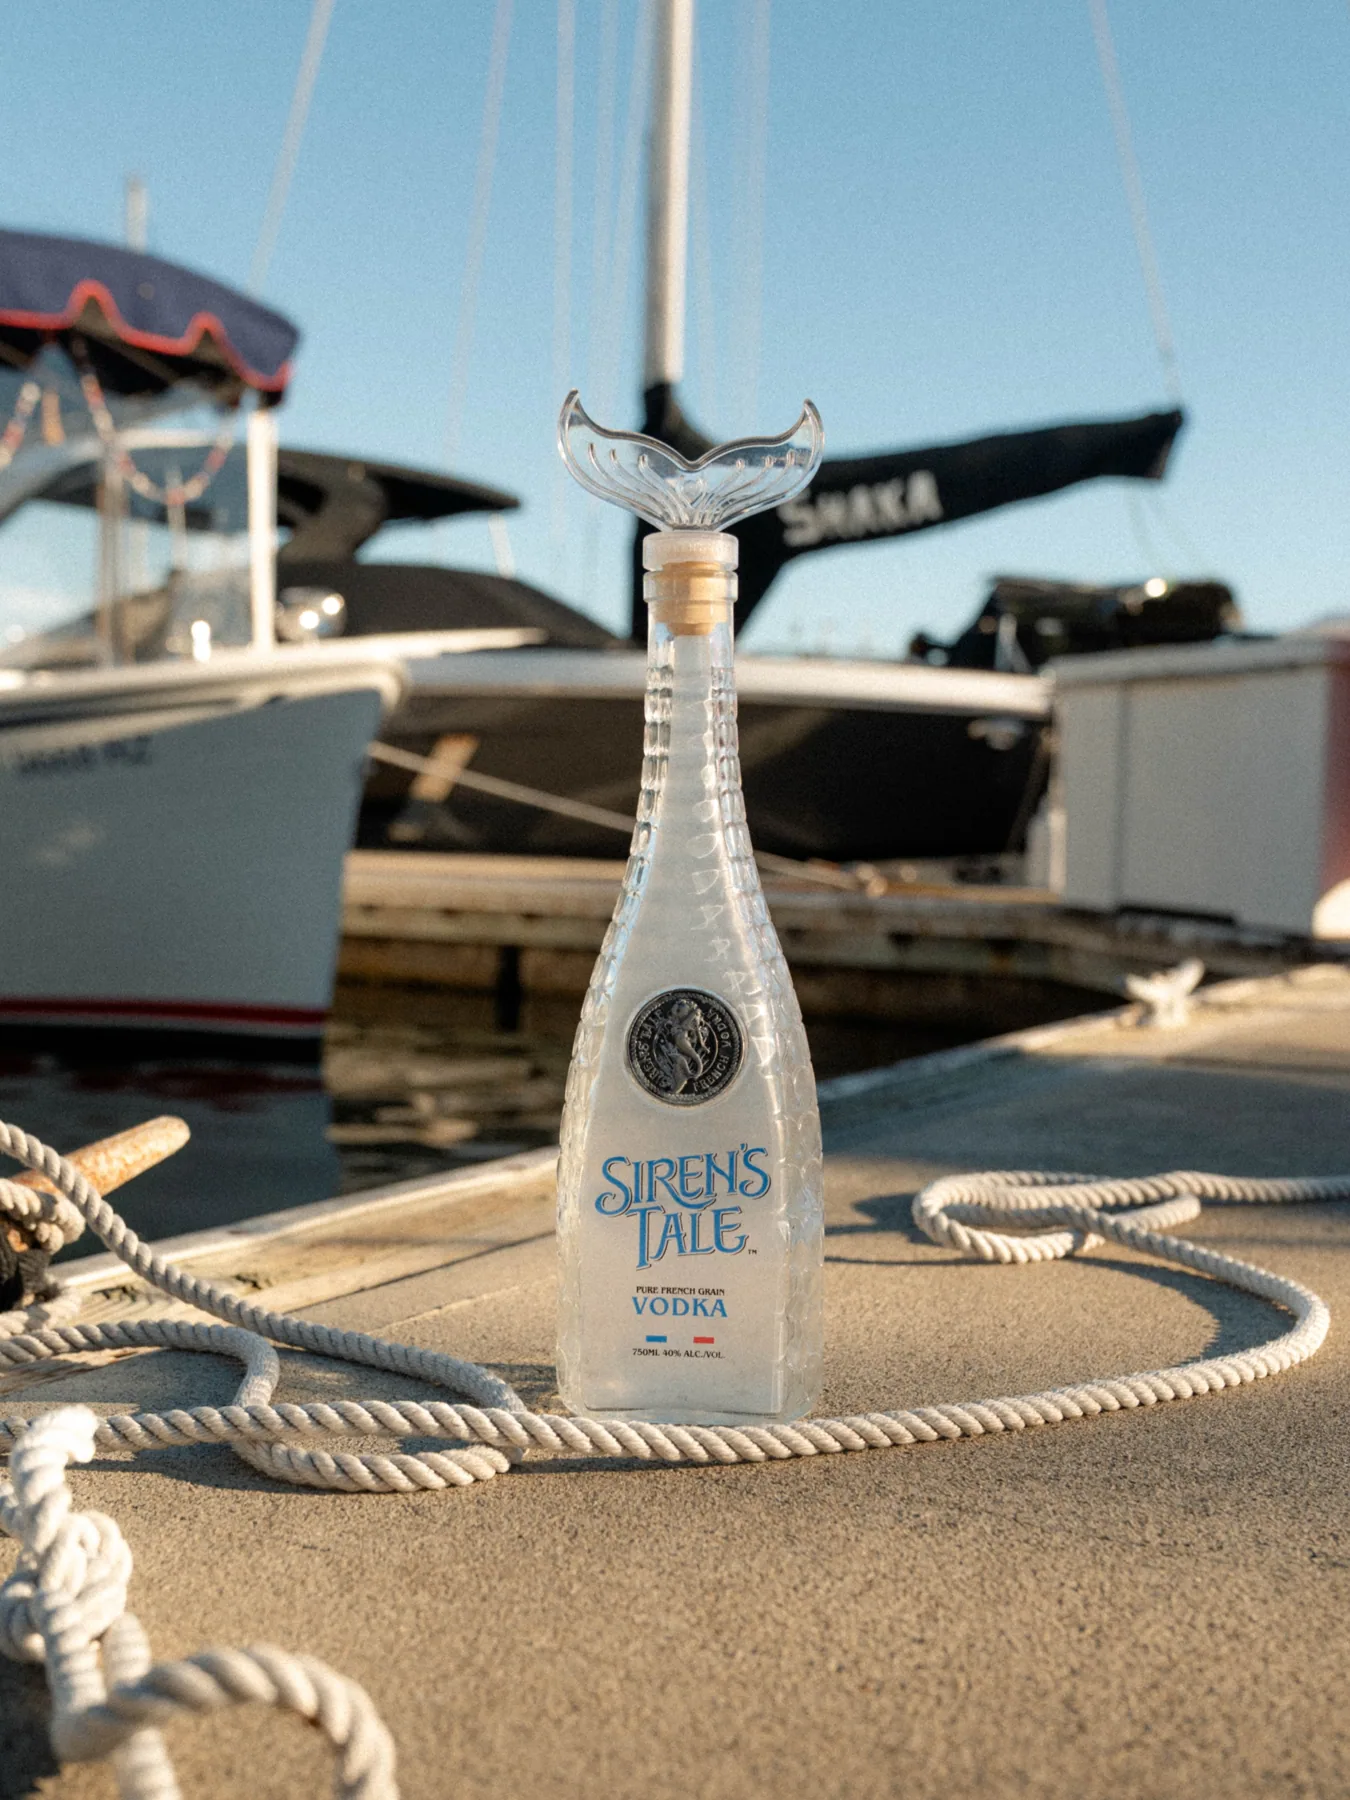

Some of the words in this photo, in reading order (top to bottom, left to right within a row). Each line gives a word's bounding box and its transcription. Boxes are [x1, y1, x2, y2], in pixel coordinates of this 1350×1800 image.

[641, 1008, 665, 1039] TALE
[707, 1008, 732, 1049] VODKA
[692, 1054, 730, 1092] FRENCH
[595, 1143, 772, 1216] SIREN'S
[626, 1205, 750, 1271] TALE
[632, 1296, 728, 1318] VODKA
[636, 1286, 659, 1294] PURE
[661, 1286, 696, 1295] FRENCH
[698, 1288, 725, 1296] GRAIN
[632, 1348, 660, 1356] 750ML
[662, 1349, 682, 1357] 40%
